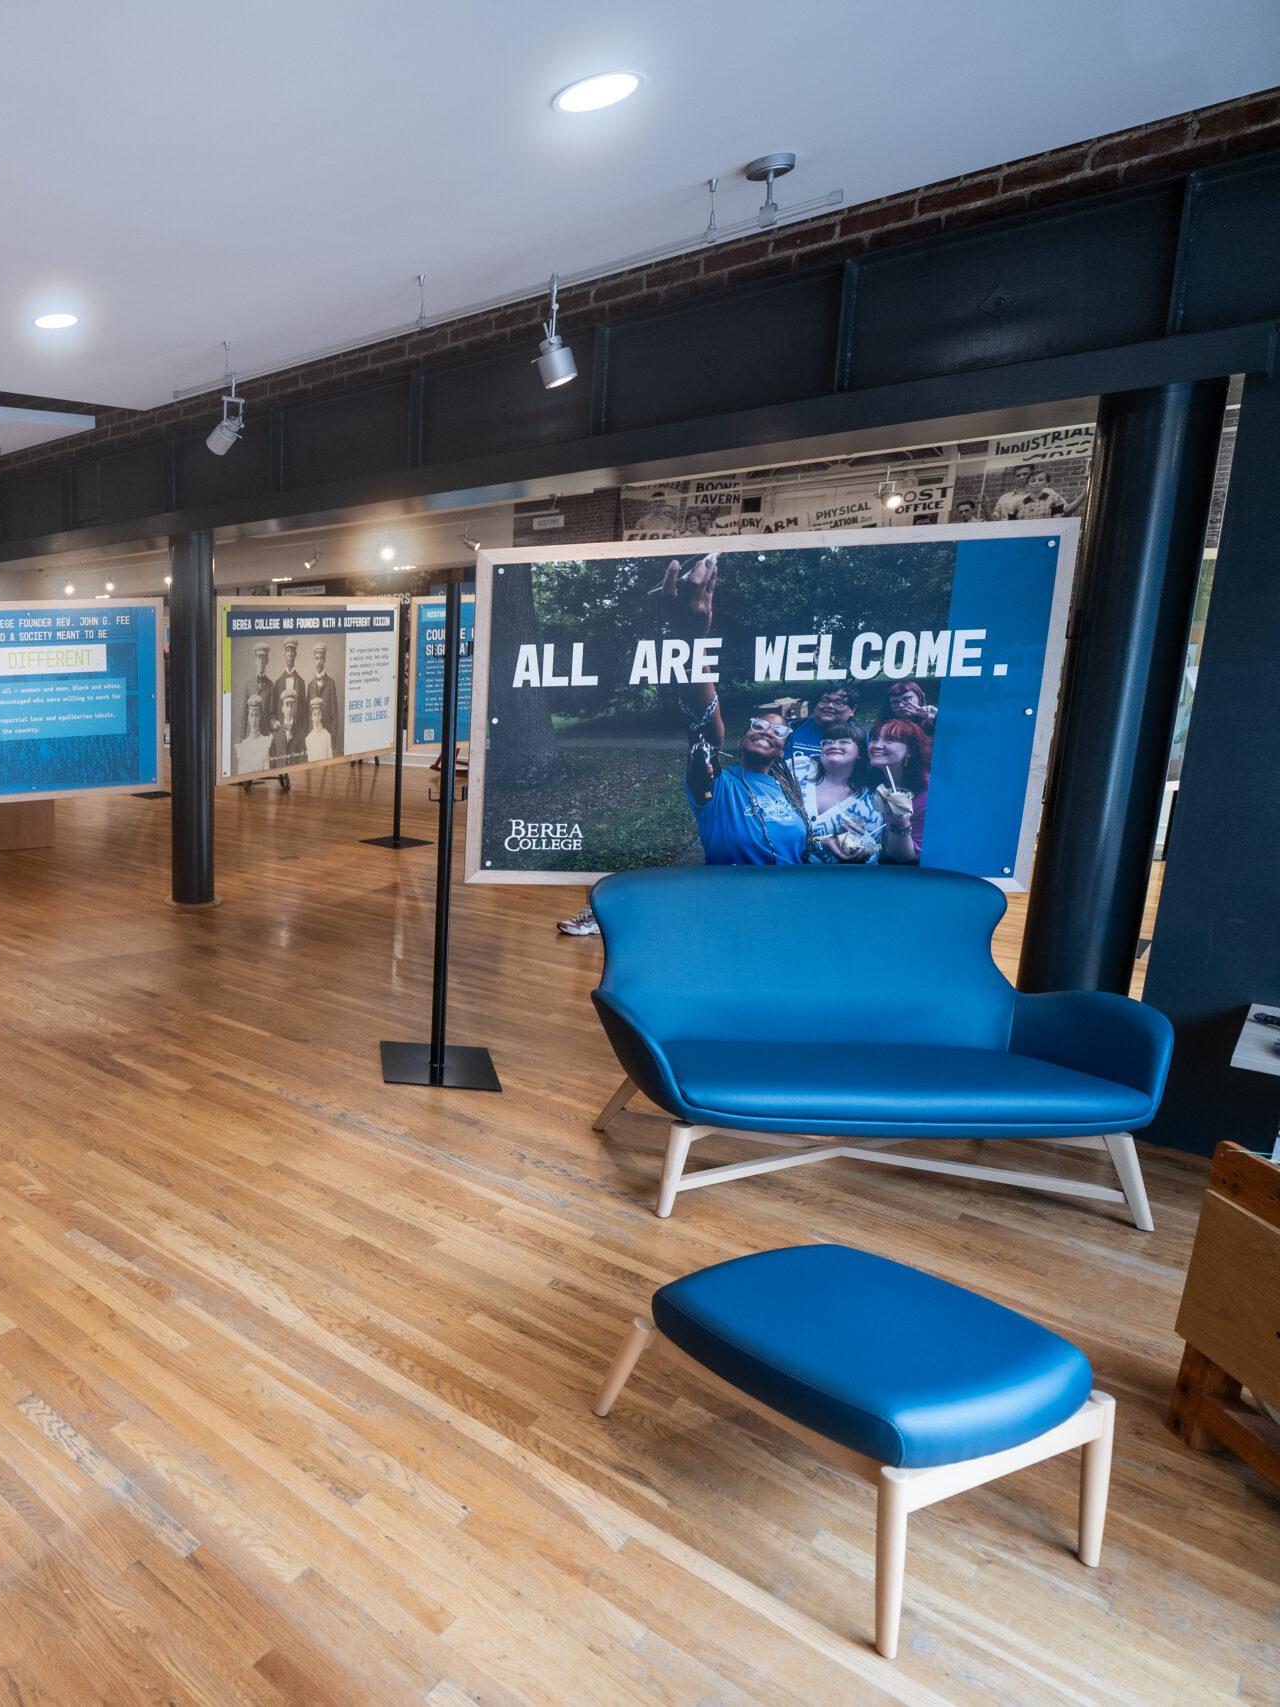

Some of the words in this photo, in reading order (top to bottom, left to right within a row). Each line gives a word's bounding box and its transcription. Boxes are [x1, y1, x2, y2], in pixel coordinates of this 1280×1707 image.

[995, 427, 1094, 455] INDUSTRIAL
[695, 482, 740, 492] BOONE
[899, 486, 953, 502] OST
[694, 494, 740, 505] TAVERN
[816, 502, 871, 520] PHYSICAL
[895, 500, 943, 514] OFFICE
[763, 517, 799, 533] ARM
[813, 516, 858, 529] CATION
[19, 617, 52, 628] FOUNDER
[56, 617, 75, 627] REV.
[80, 616, 98, 626] JOHN
[102, 616, 111, 626] G.
[116, 615, 130, 625] FEE
[232, 618, 251, 630] BEREA
[255, 618, 280, 630] COLLEGE
[282, 617, 294, 629] WAS
[296, 617, 319, 629] FOUNDED
[322, 617, 335, 628] WITH
[337, 617, 342, 627] A
[344, 616, 371, 628] DIFFERENT
[373, 616, 390, 627] VISION
[9, 632, 15, 642] A
[19, 631, 52, 641] SOCIETY
[56, 630, 80, 640] MEANT
[85, 629, 94, 639] TO
[98, 629, 108, 638] BE
[8, 649, 103, 670] DIFFERENT.
[512, 642, 599, 688] ALL
[629, 637, 723, 685] ARE
[754, 628, 1008, 682] WELCOME.
[62, 695, 85, 703] willing
[349, 700, 363, 710] BEREA
[365, 699, 371, 708] IS
[373, 697, 382, 707] ONE
[384, 696, 390, 706] OF
[349, 713, 363, 723] THOSE
[509, 819, 584, 838] BEREA
[504, 836, 583, 852] COLLEGE
